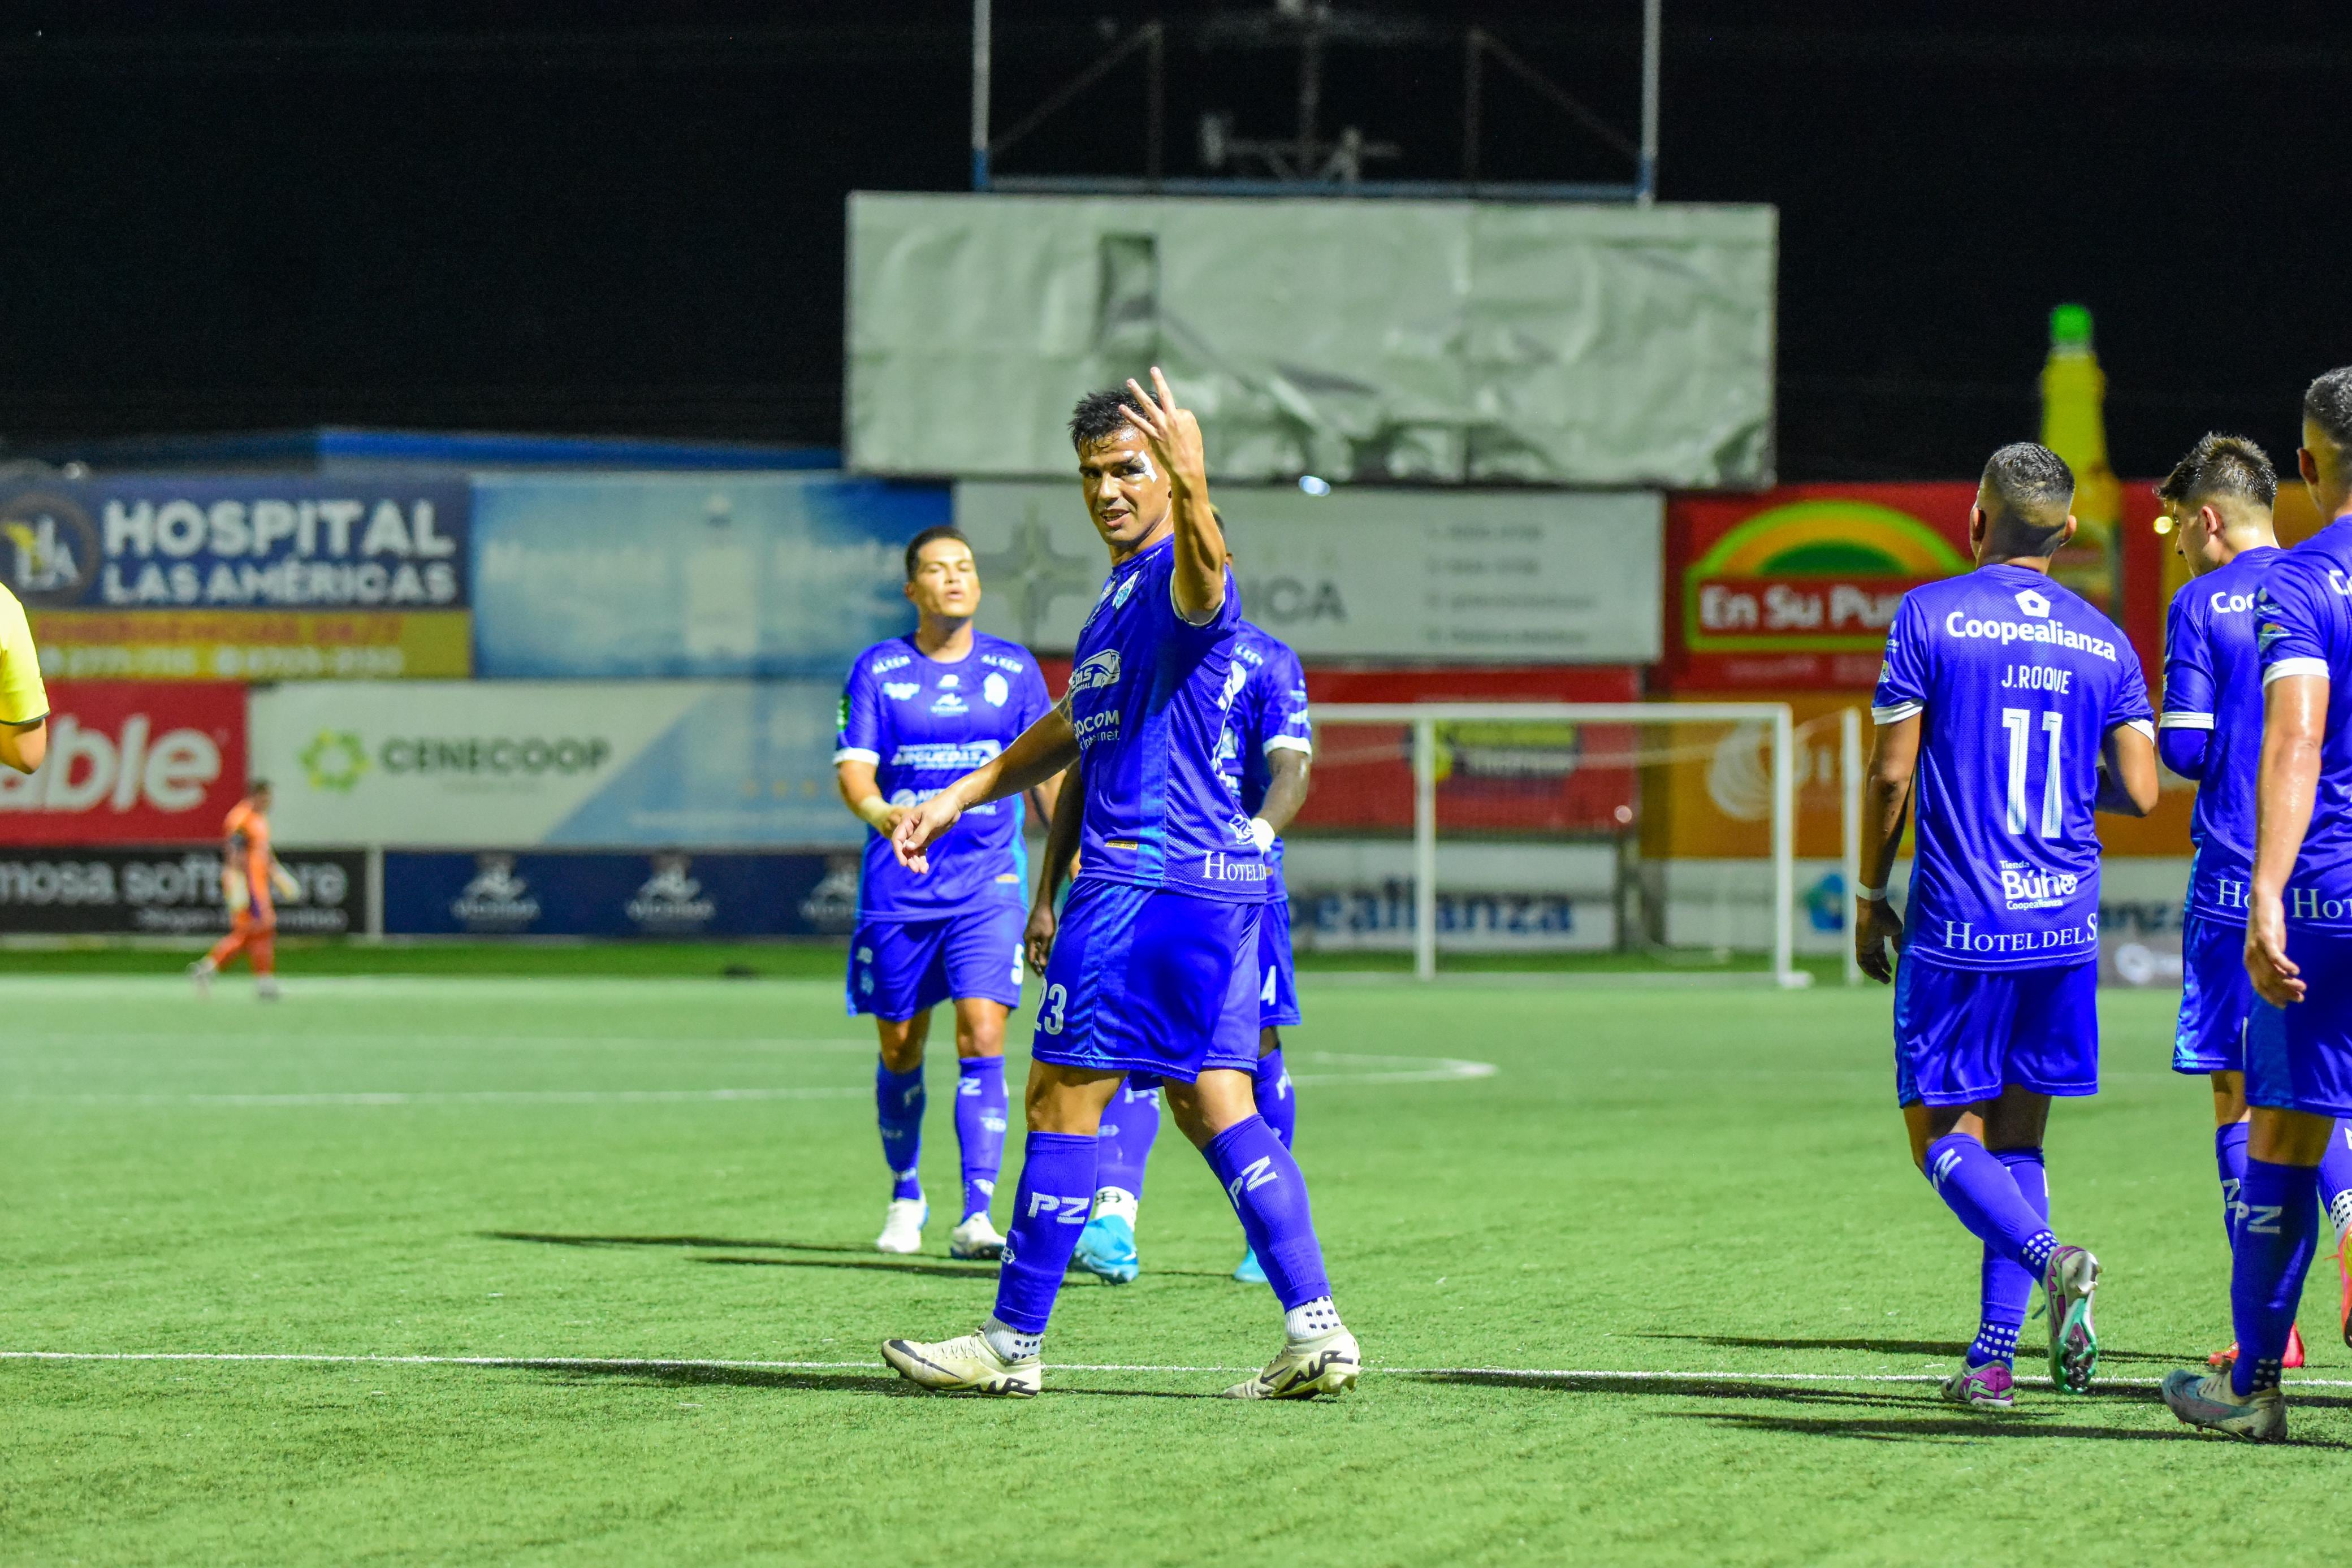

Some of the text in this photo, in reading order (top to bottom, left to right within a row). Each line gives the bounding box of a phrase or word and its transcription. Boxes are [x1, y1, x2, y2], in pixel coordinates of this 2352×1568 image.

[102, 500, 455, 557] HOSPITAL
[103, 563, 200, 604] LAS
[207, 555, 455, 604] AMÉRICAS
[1700, 584, 1759, 629] En
[1765, 584, 1822, 629] Su
[1946, 612, 2116, 661] Coopealianza
[2001, 664, 2072, 695] J.ROQUE
[380, 737, 611, 775] CENECOOP
[890, 750, 981, 766] ARGUEDAS
[2002, 708, 2063, 838] 11
[1203, 850, 1259, 881] HOTEL
[2000, 860, 2030, 869] Tienda
[2001, 868, 2078, 900] Búho
[2007, 899, 2063, 911] Coopealianza
[1944, 920, 2039, 952] HOTEL
[2043, 927, 2085, 947] DEL
[1010, 943, 1024, 985] 5
[1260, 965, 1277, 1006] 4
[1035, 977, 1067, 1035] 23
[1229, 1155, 1278, 1210] PZ
[1027, 1192, 1089, 1224] PZ
[2234, 1201, 2282, 1235] PZ
